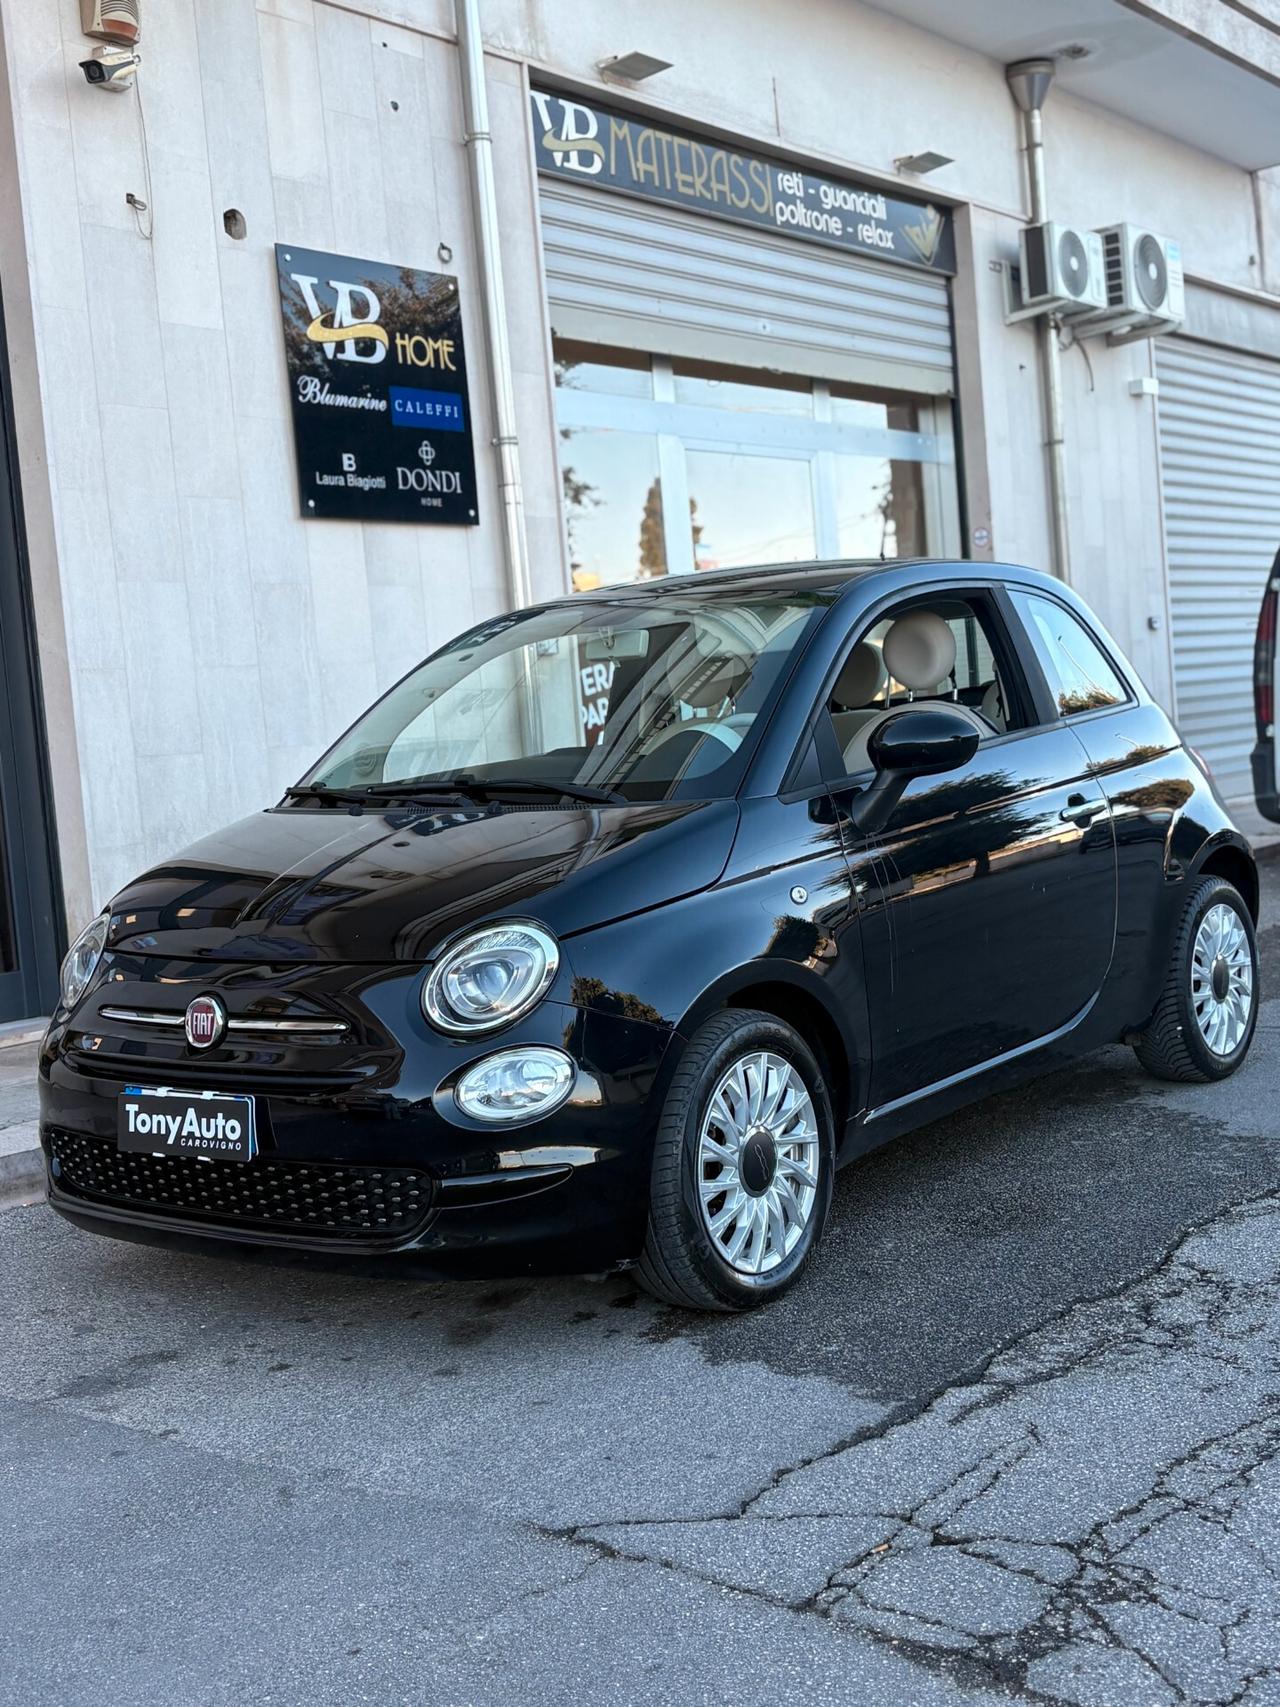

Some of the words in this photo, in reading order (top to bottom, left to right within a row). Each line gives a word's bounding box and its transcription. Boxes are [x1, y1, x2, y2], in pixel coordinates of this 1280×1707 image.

[609, 118, 774, 218] MATERASSI
[776, 171, 804, 196] reti
[819, 184, 887, 220] guanciali
[775, 199, 842, 236] poltrone
[857, 221, 895, 250] relax
[395, 332, 456, 371] HOME
[297, 374, 387, 412] Blumarine
[394, 399, 459, 419] CALEFFI
[341, 453, 357, 471] B
[315, 471, 346, 487] Laura
[346, 473, 387, 491] Biagiotti
[396, 467, 462, 494] DONDI
[420, 497, 443, 508] HOME
[192, 1012, 213, 1036] FIAT
[125, 1103, 242, 1145] TonyAuto
[180, 1138, 242, 1151] CAROVIGNO
